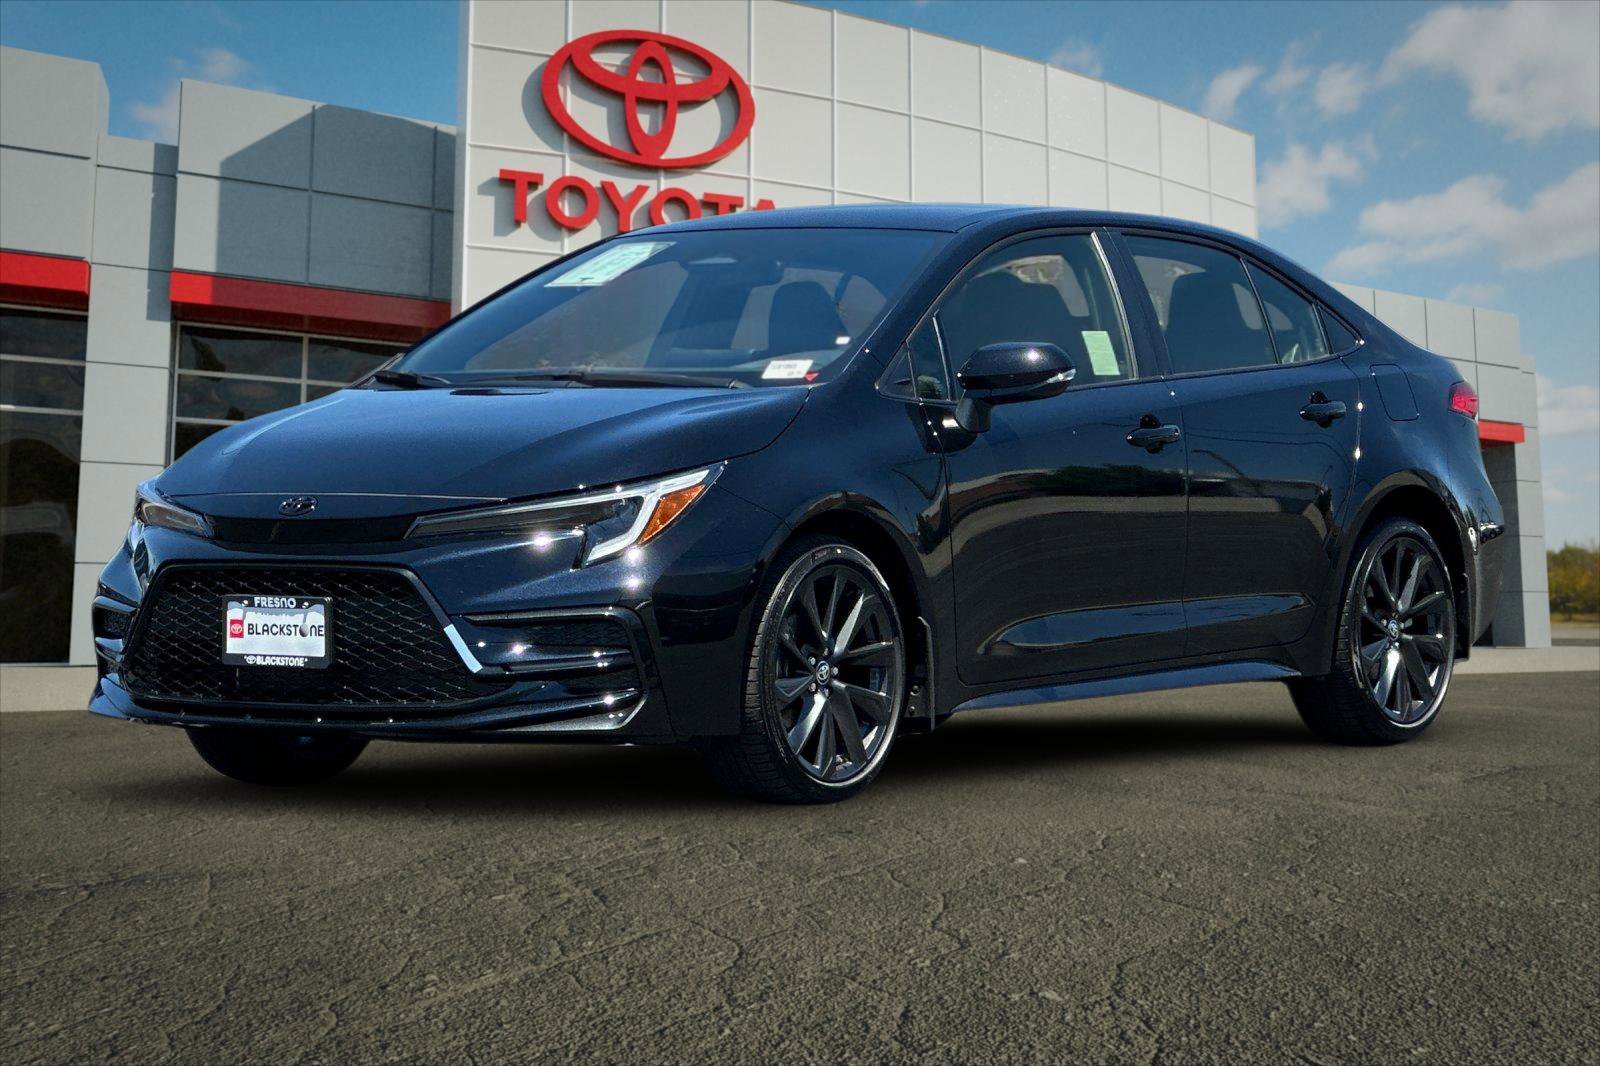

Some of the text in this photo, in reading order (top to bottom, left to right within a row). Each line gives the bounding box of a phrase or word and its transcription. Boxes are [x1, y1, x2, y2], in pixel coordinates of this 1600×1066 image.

[499, 169, 776, 232] TOYOT
[254, 597, 296, 608] FRESNO
[247, 623, 324, 637] BLACKSTONE
[256, 656, 304, 667] BLACKSTONE
